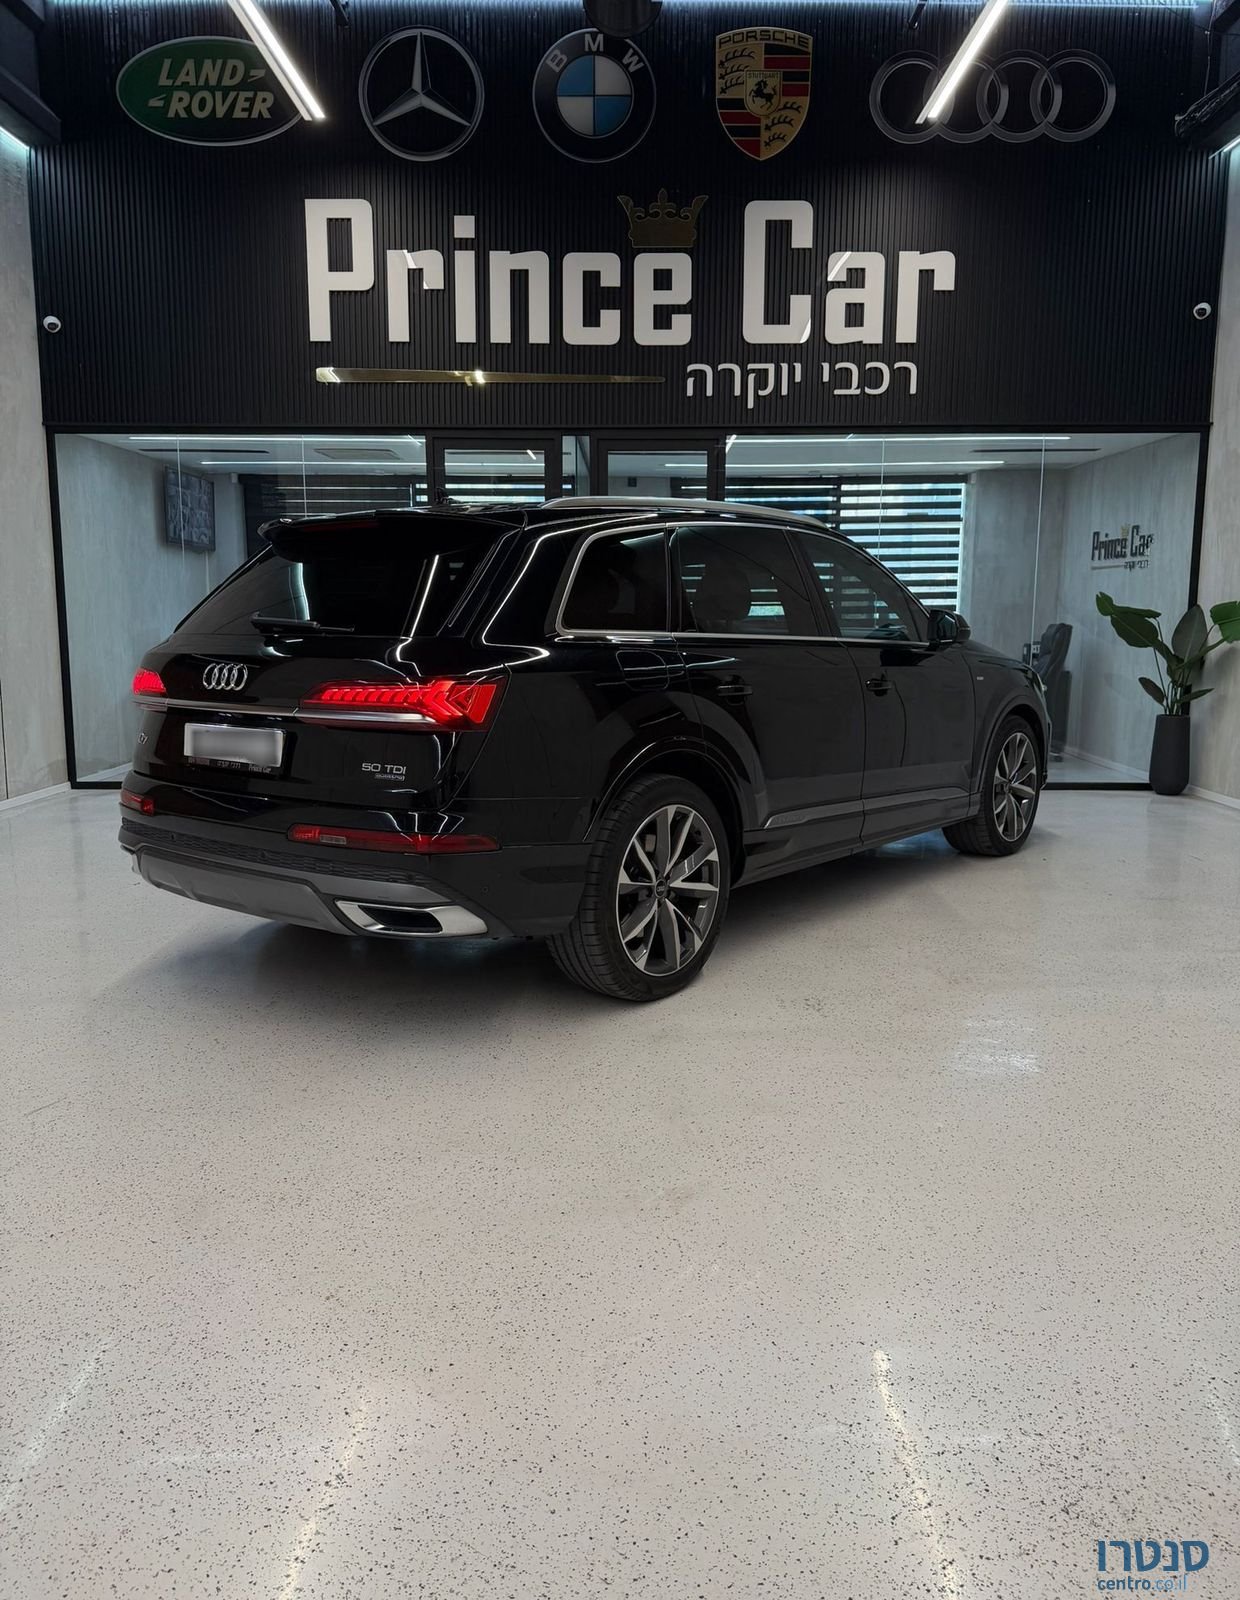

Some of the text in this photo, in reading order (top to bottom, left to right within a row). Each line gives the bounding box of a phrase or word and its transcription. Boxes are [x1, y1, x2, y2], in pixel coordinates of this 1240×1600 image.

[545, 33, 645, 73] BMW
[719, 30, 809, 48] PORSCHE
[158, 58, 246, 87] LAND
[167, 90, 275, 119] ROVER
[304, 198, 957, 346] Prince Car
[686, 361, 919, 410] רכבי יוקרה
[1091, 531, 1128, 561] Prince
[361, 763, 407, 775] 50 TDI
